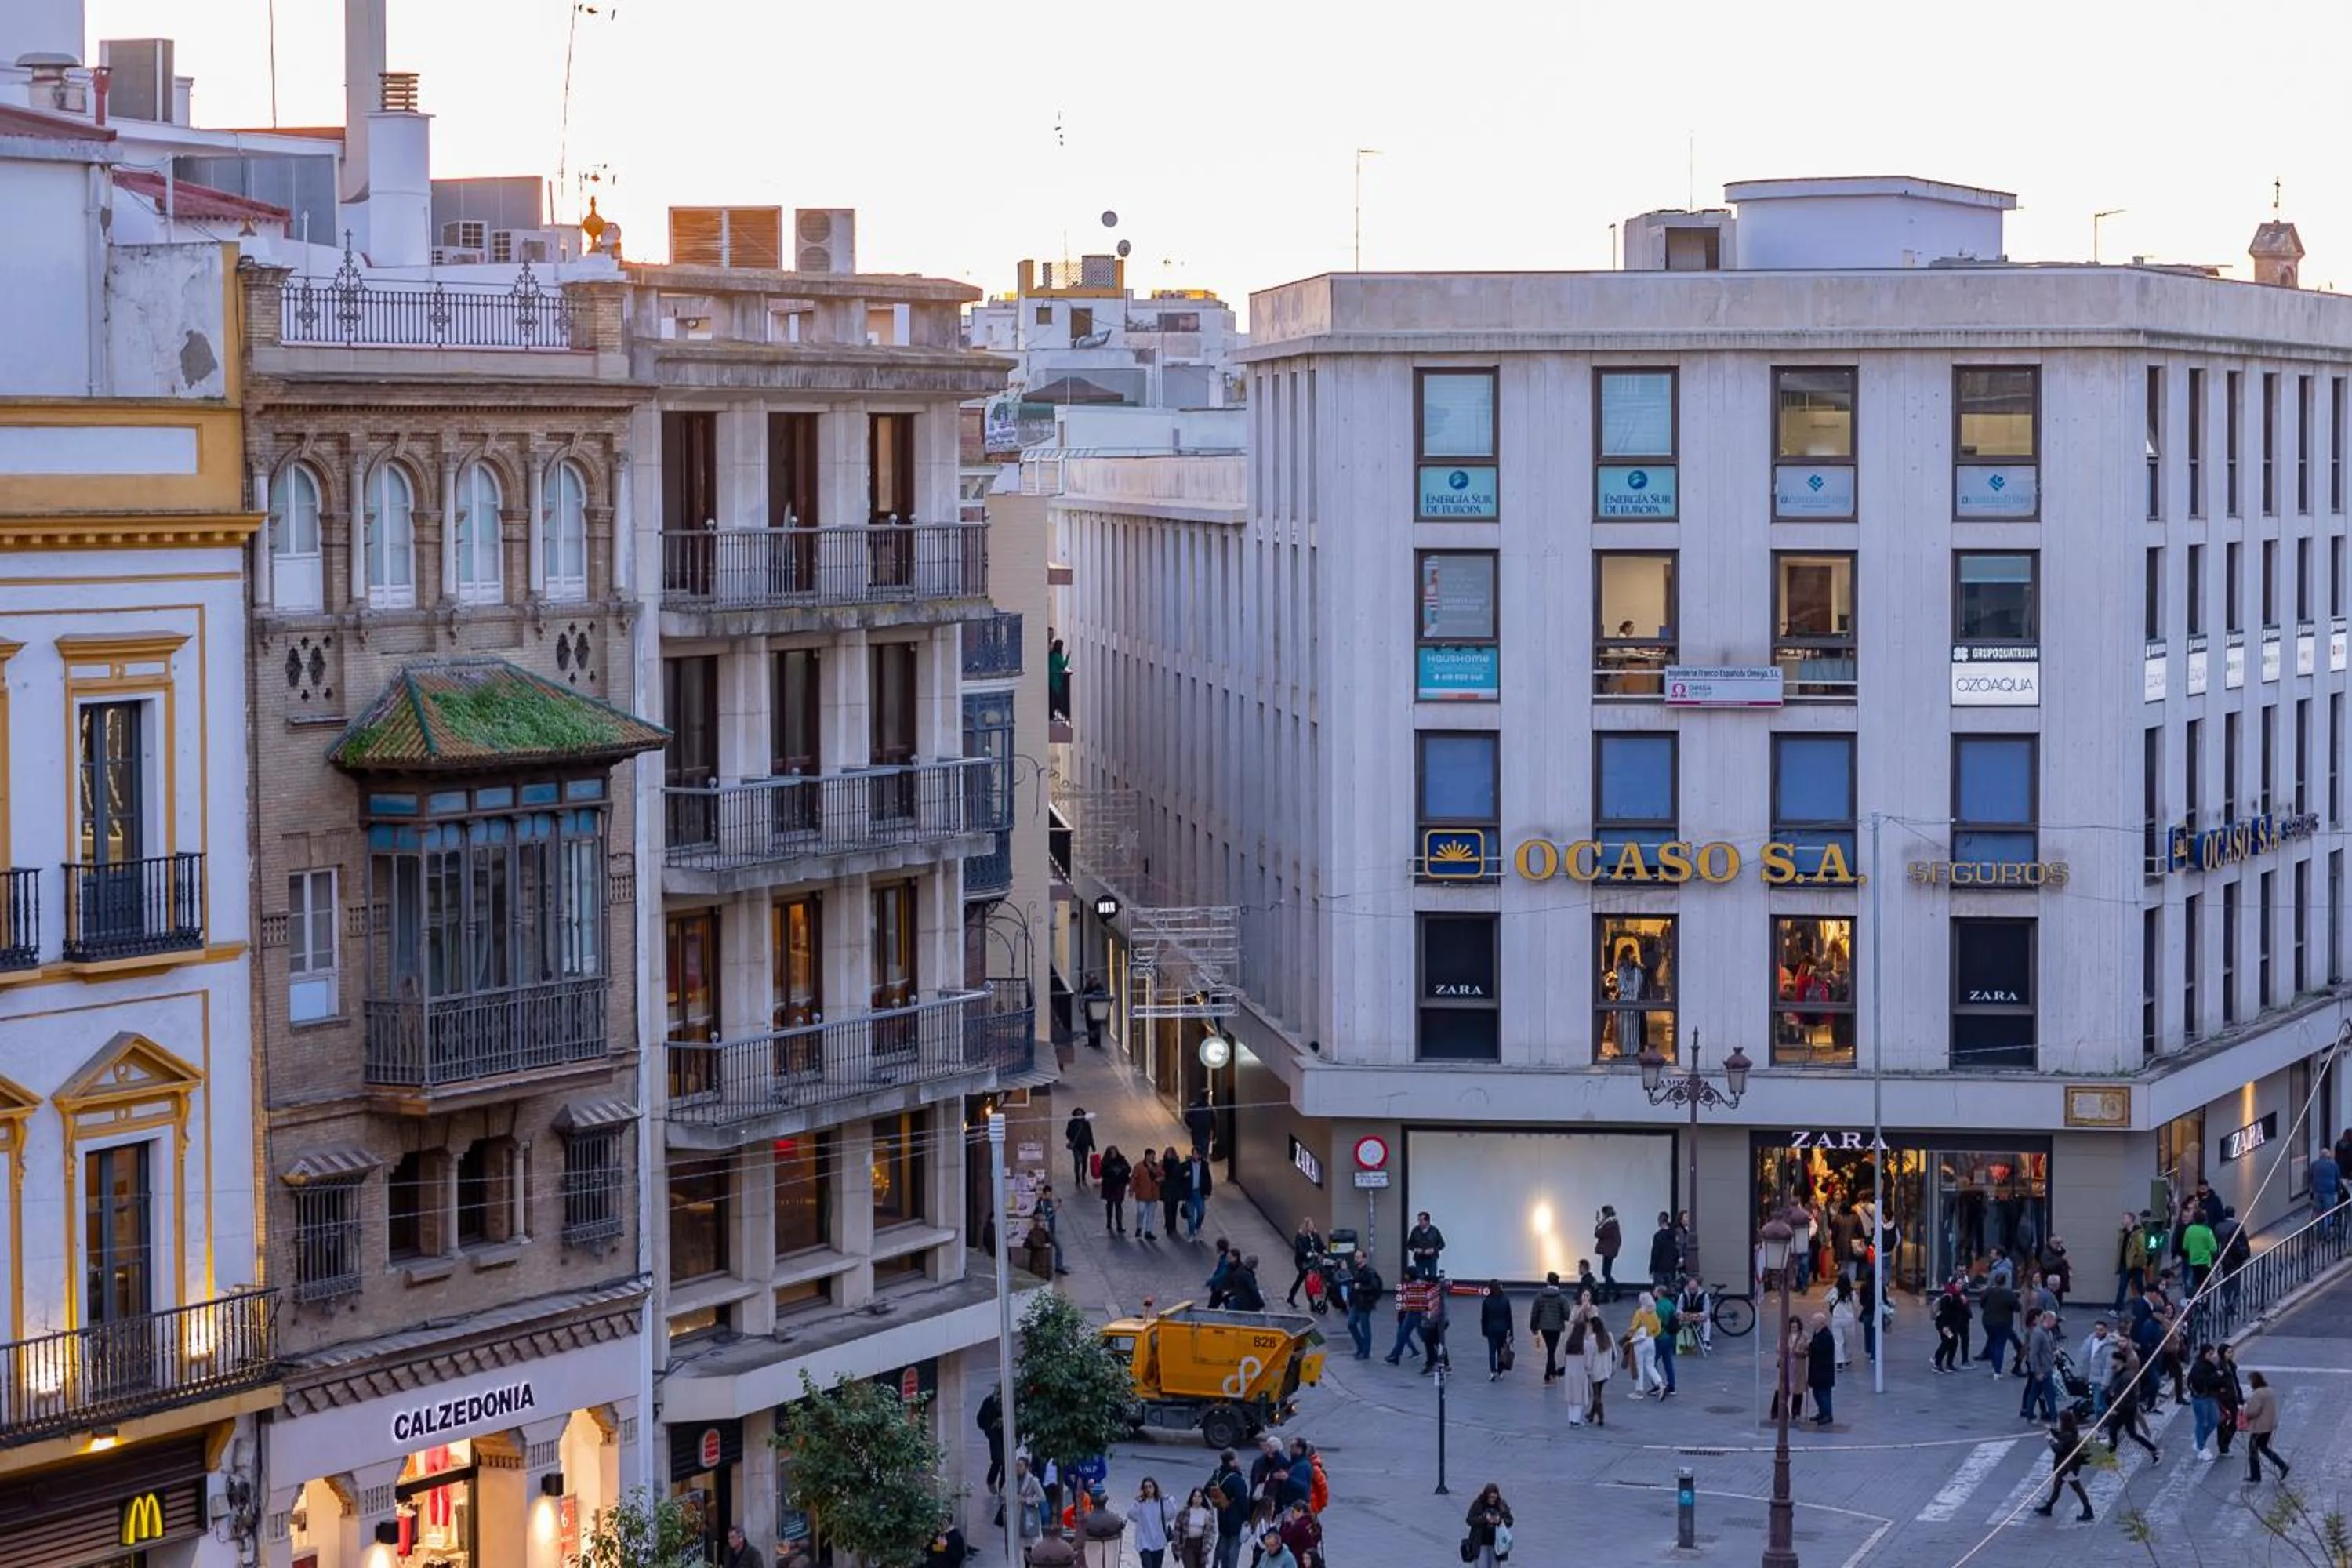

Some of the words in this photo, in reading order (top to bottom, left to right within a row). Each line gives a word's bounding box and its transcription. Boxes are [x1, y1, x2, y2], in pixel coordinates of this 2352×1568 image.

[1957, 677, 2033, 692] OZOAQUA
[2203, 821, 2251, 872] OCASO
[1514, 838, 1741, 884] OCASO
[1760, 842, 1867, 885] S.A.
[1907, 862, 2070, 889] SEGUROS
[1436, 985, 1484, 995] ZARA
[1969, 990, 2019, 1001] ZARA
[1791, 1131, 1889, 1149] ZARA
[2229, 1120, 2265, 1158] ZARA
[394, 1383, 535, 1440] CALZEDONIA
